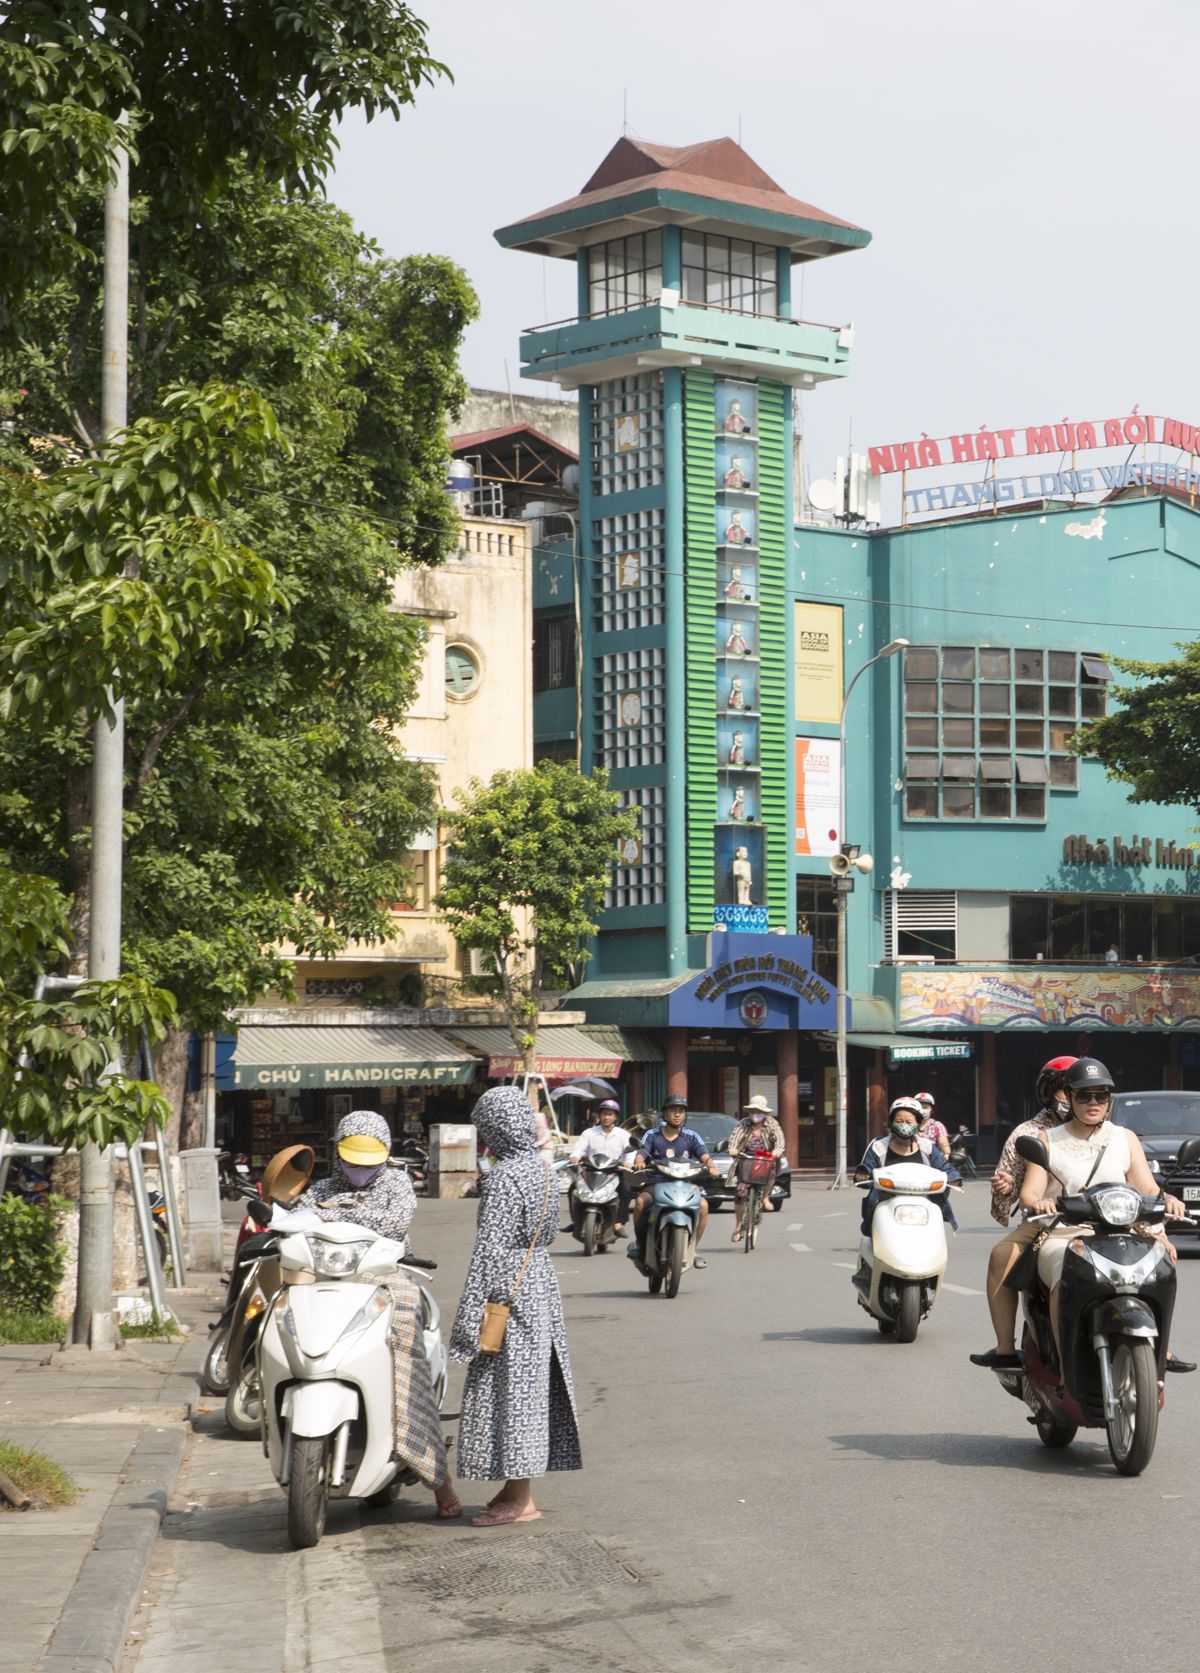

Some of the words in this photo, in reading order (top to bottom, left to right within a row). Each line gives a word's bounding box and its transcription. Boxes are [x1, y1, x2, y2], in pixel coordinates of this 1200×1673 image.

[868, 432, 942, 476] NHÀ
[950, 424, 1015, 463] HÁT
[1026, 416, 1097, 455] MÚA
[906, 477, 1015, 513] THANG
[1021, 469, 1095, 498] LONG
[1100, 462, 1182, 489] WATER
[802, 632, 828, 641] ASIA
[894, 1047, 934, 1058] BOOKING
[936, 1045, 966, 1056] TICKET
[324, 1066, 461, 1083] HANDICRAFT
[564, 1061, 618, 1074] HANDICRAFTS
